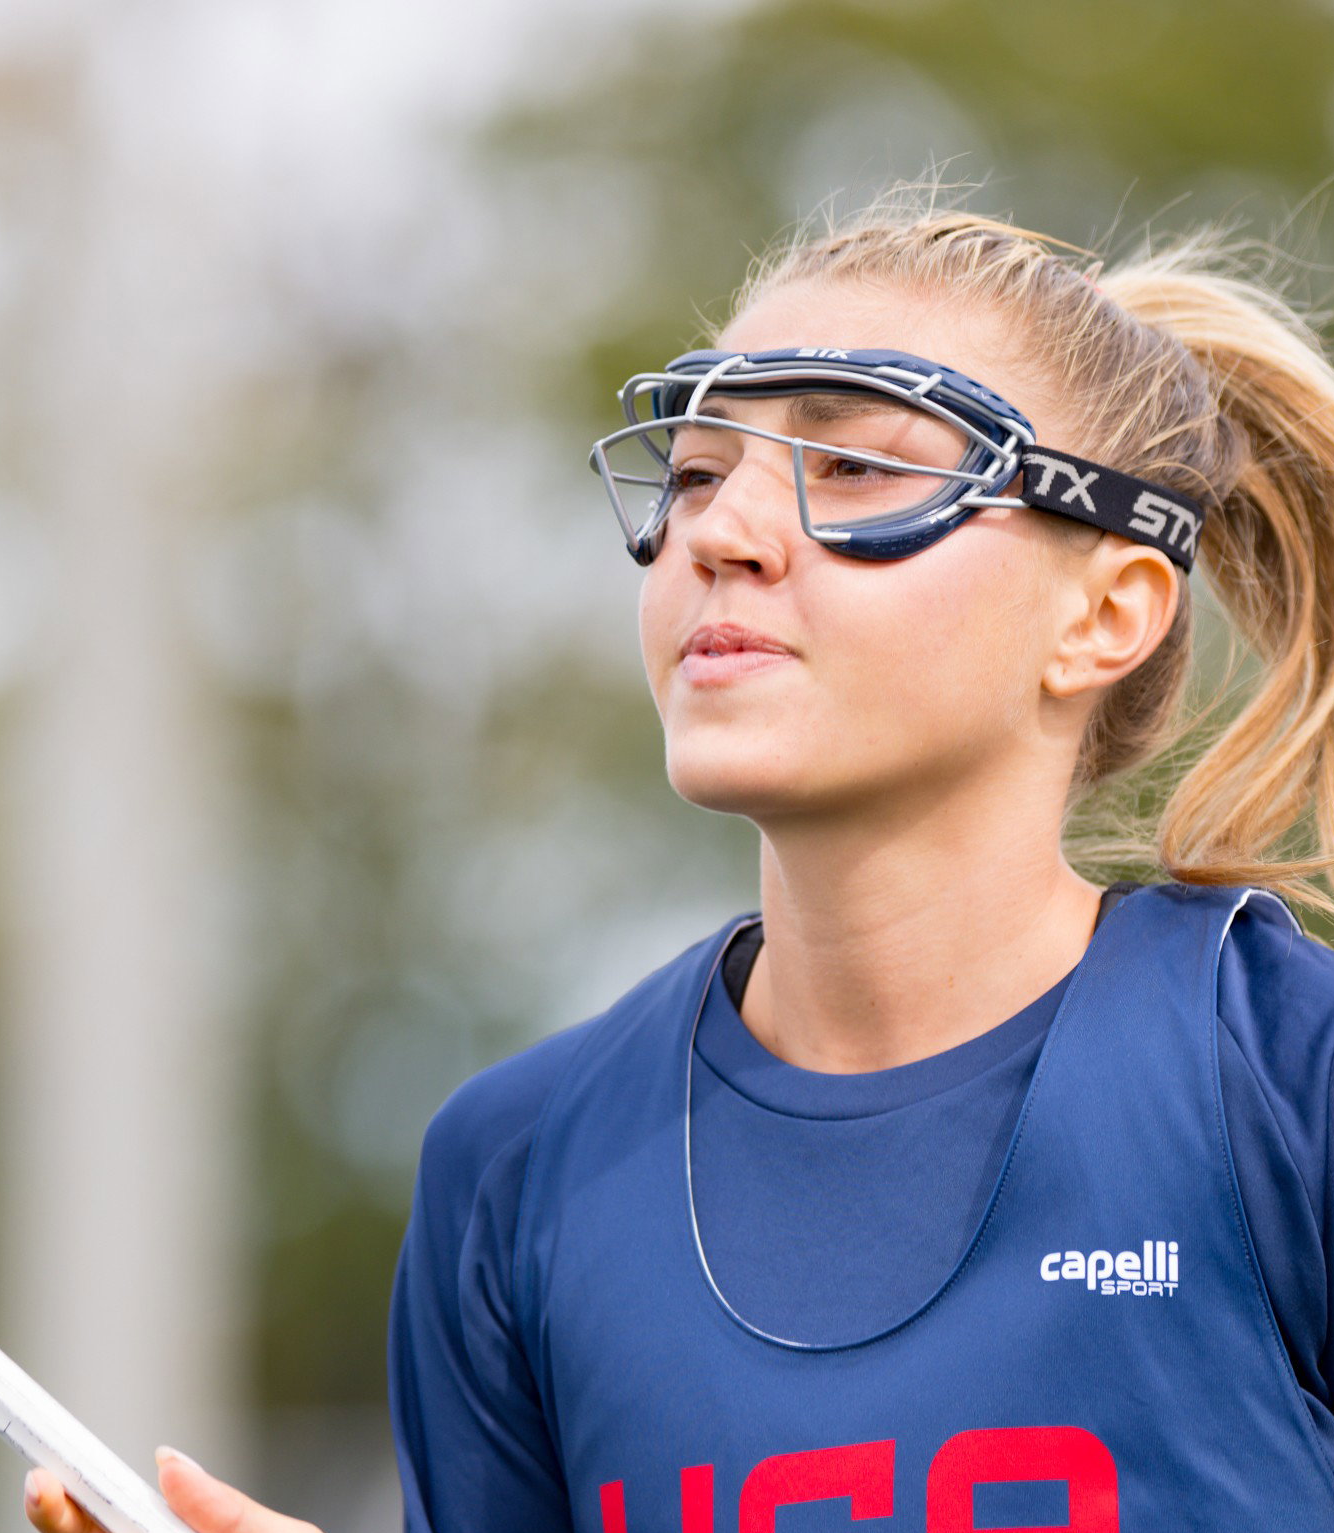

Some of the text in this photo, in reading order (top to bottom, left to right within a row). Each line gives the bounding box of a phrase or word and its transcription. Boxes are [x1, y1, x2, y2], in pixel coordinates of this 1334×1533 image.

[795, 347, 854, 360] STX
[1024, 453, 1204, 558] TX STX
[1040, 1240, 1179, 1291] capelli
[1100, 1280, 1179, 1298] SPORT
